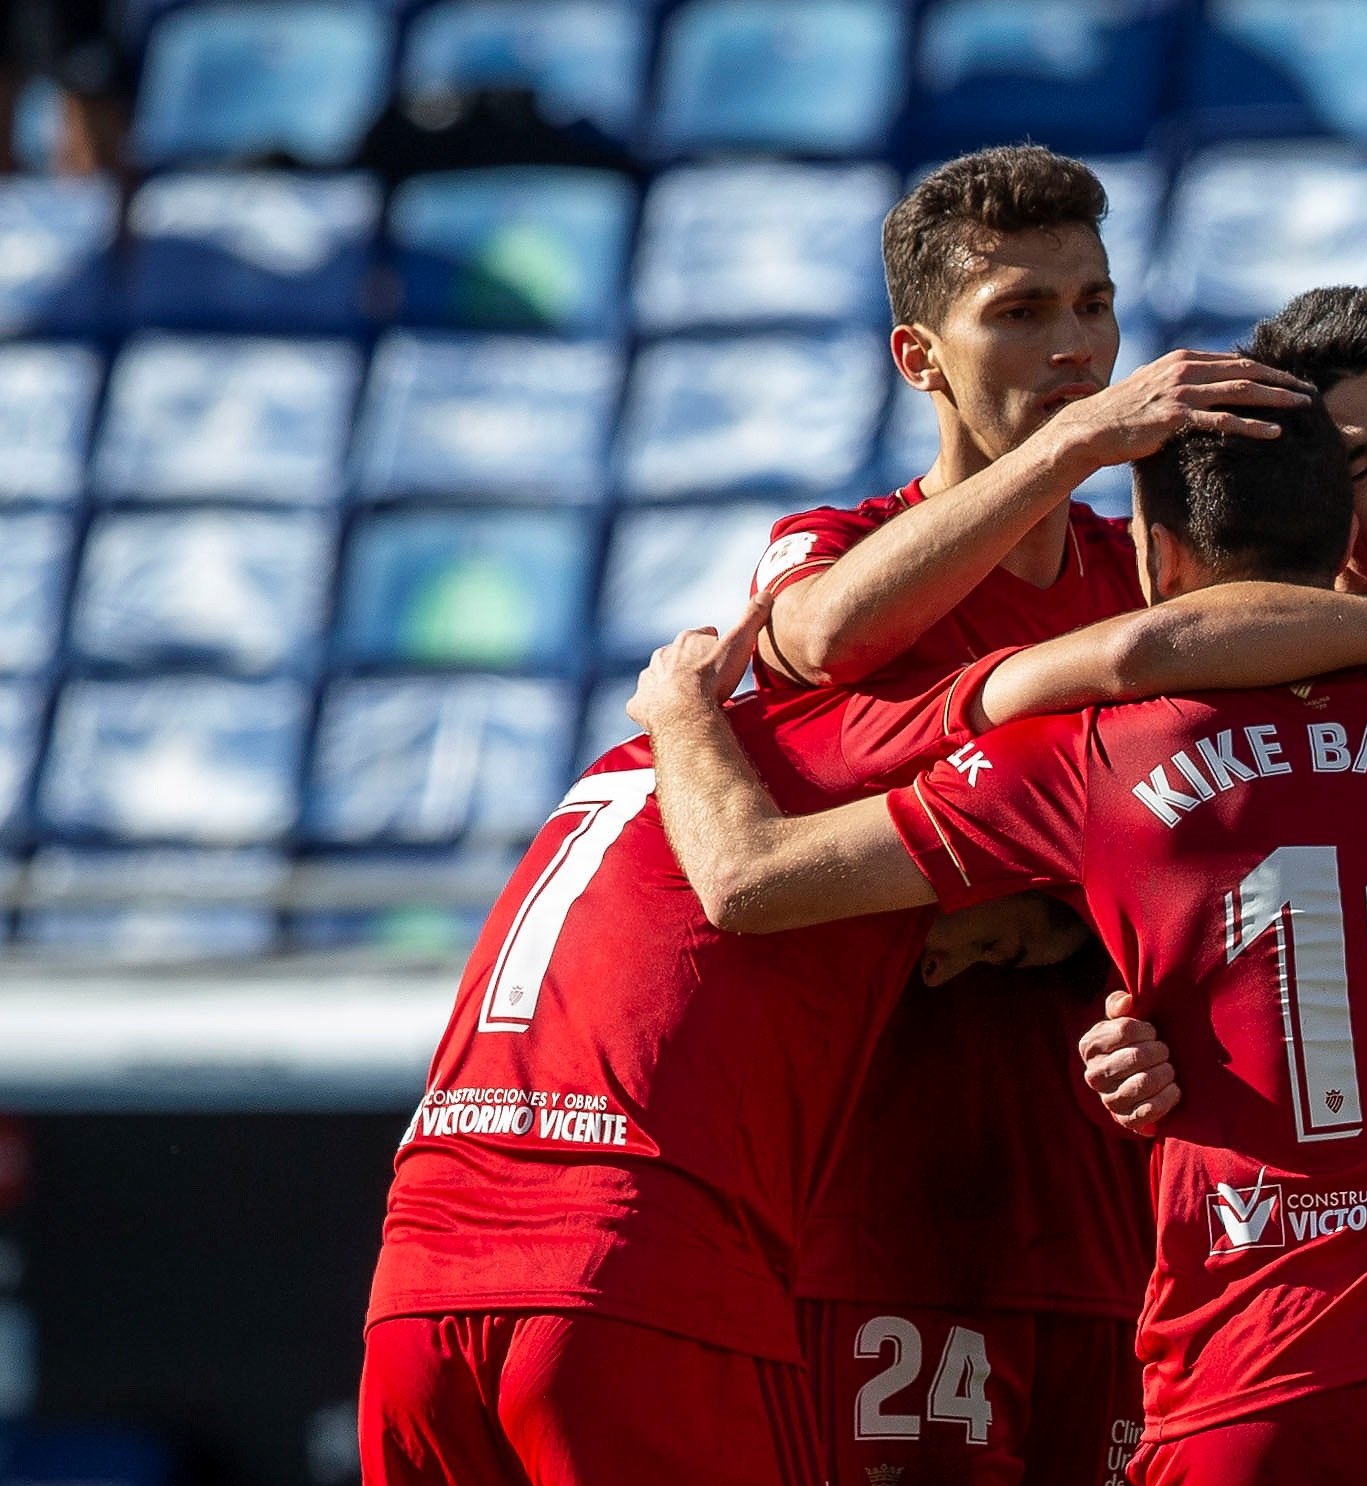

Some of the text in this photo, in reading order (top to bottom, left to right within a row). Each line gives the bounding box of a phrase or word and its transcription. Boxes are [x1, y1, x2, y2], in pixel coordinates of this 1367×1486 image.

[1131, 724, 1293, 829] KIKE
[478, 768, 657, 1033] 7
[422, 1104, 627, 1145] VICTORINO VICENTE
[424, 1088, 608, 1111] CONSTRUCCIONES Y OBRAS
[854, 1315, 993, 1445] 24
